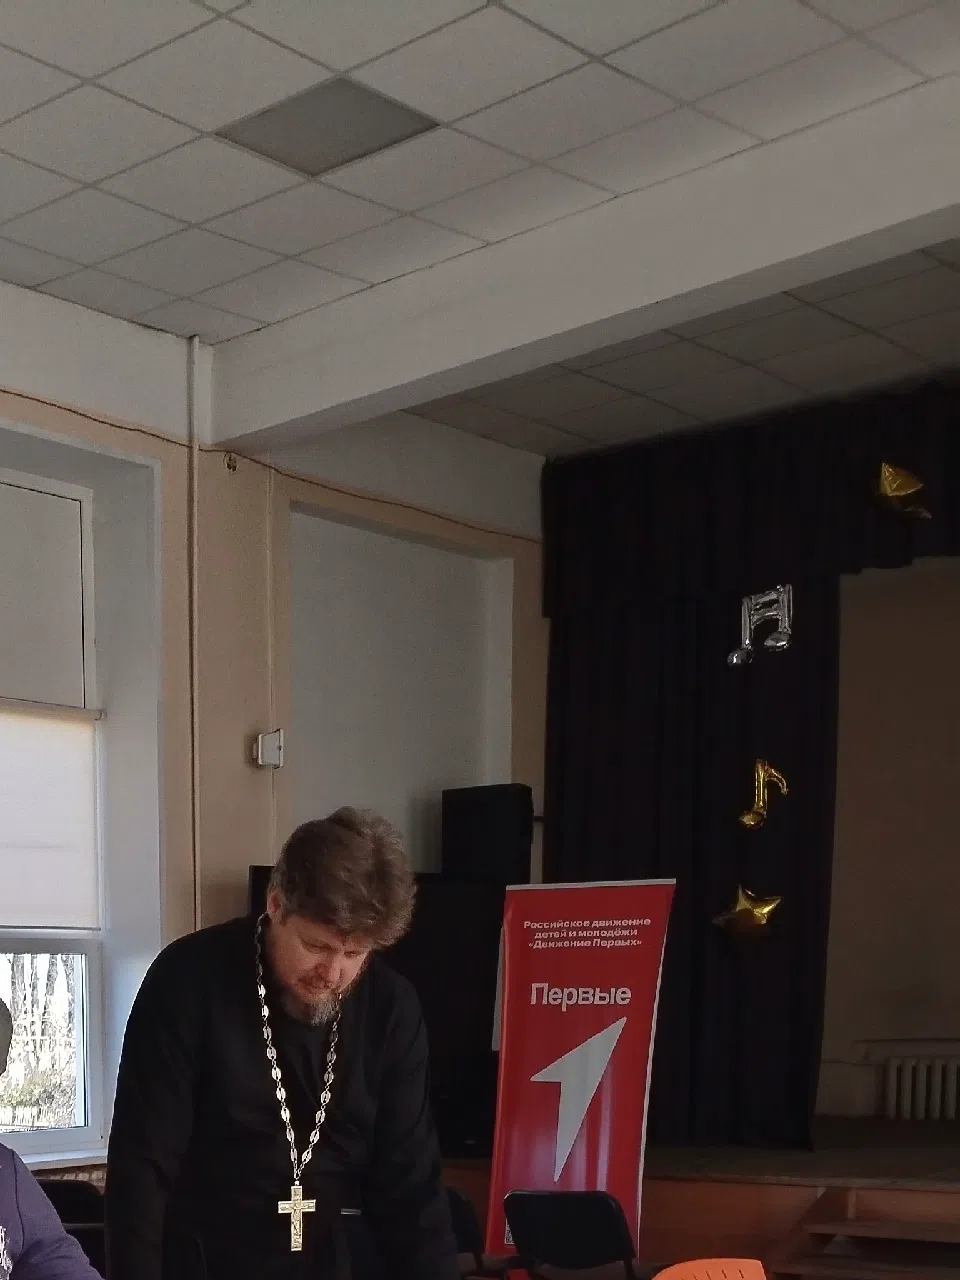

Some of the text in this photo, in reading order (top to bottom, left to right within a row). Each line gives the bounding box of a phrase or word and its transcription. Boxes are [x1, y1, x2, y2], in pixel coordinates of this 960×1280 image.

[523, 918, 652, 929] Российское движение
[534, 928, 638, 939] детей и молодёжи
[530, 982, 632, 1012] Первые
